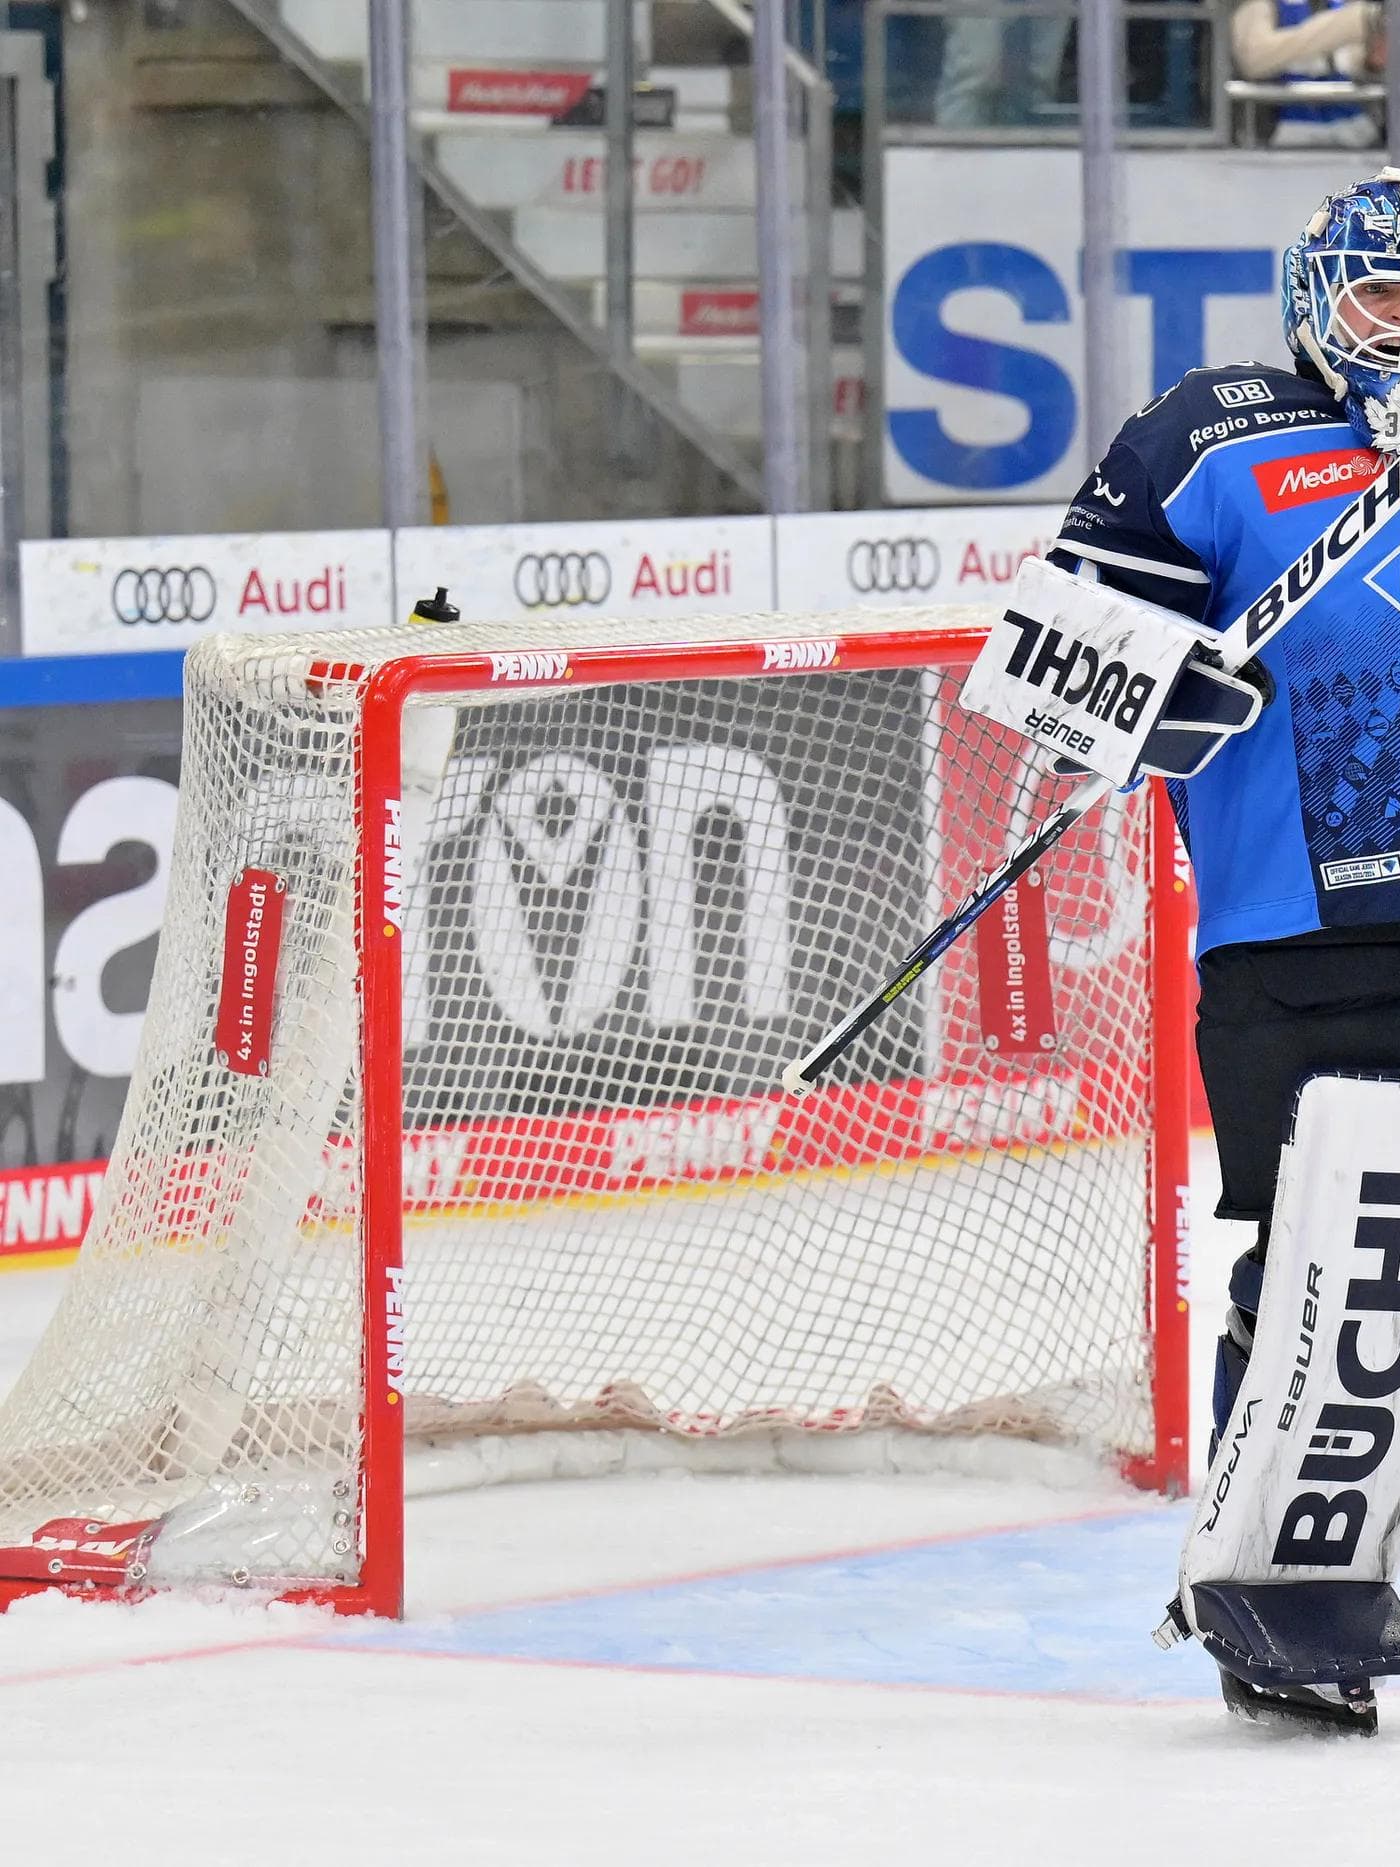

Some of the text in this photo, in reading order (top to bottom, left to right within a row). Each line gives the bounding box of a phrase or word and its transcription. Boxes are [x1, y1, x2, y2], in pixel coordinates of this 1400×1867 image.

[1220, 383, 1266, 404] DB
[1189, 416, 1249, 452] Regio
[632, 551, 732, 599] Audi
[957, 537, 1041, 585] Au
[238, 566, 347, 616] Audi
[235, 882, 268, 1062] 4x in Ingolstadt
[1001, 880, 1028, 1042] 4x in Ingolstad
[1278, 1262, 1325, 1432] BAUER
[1197, 1398, 1263, 1536] VAPOR
